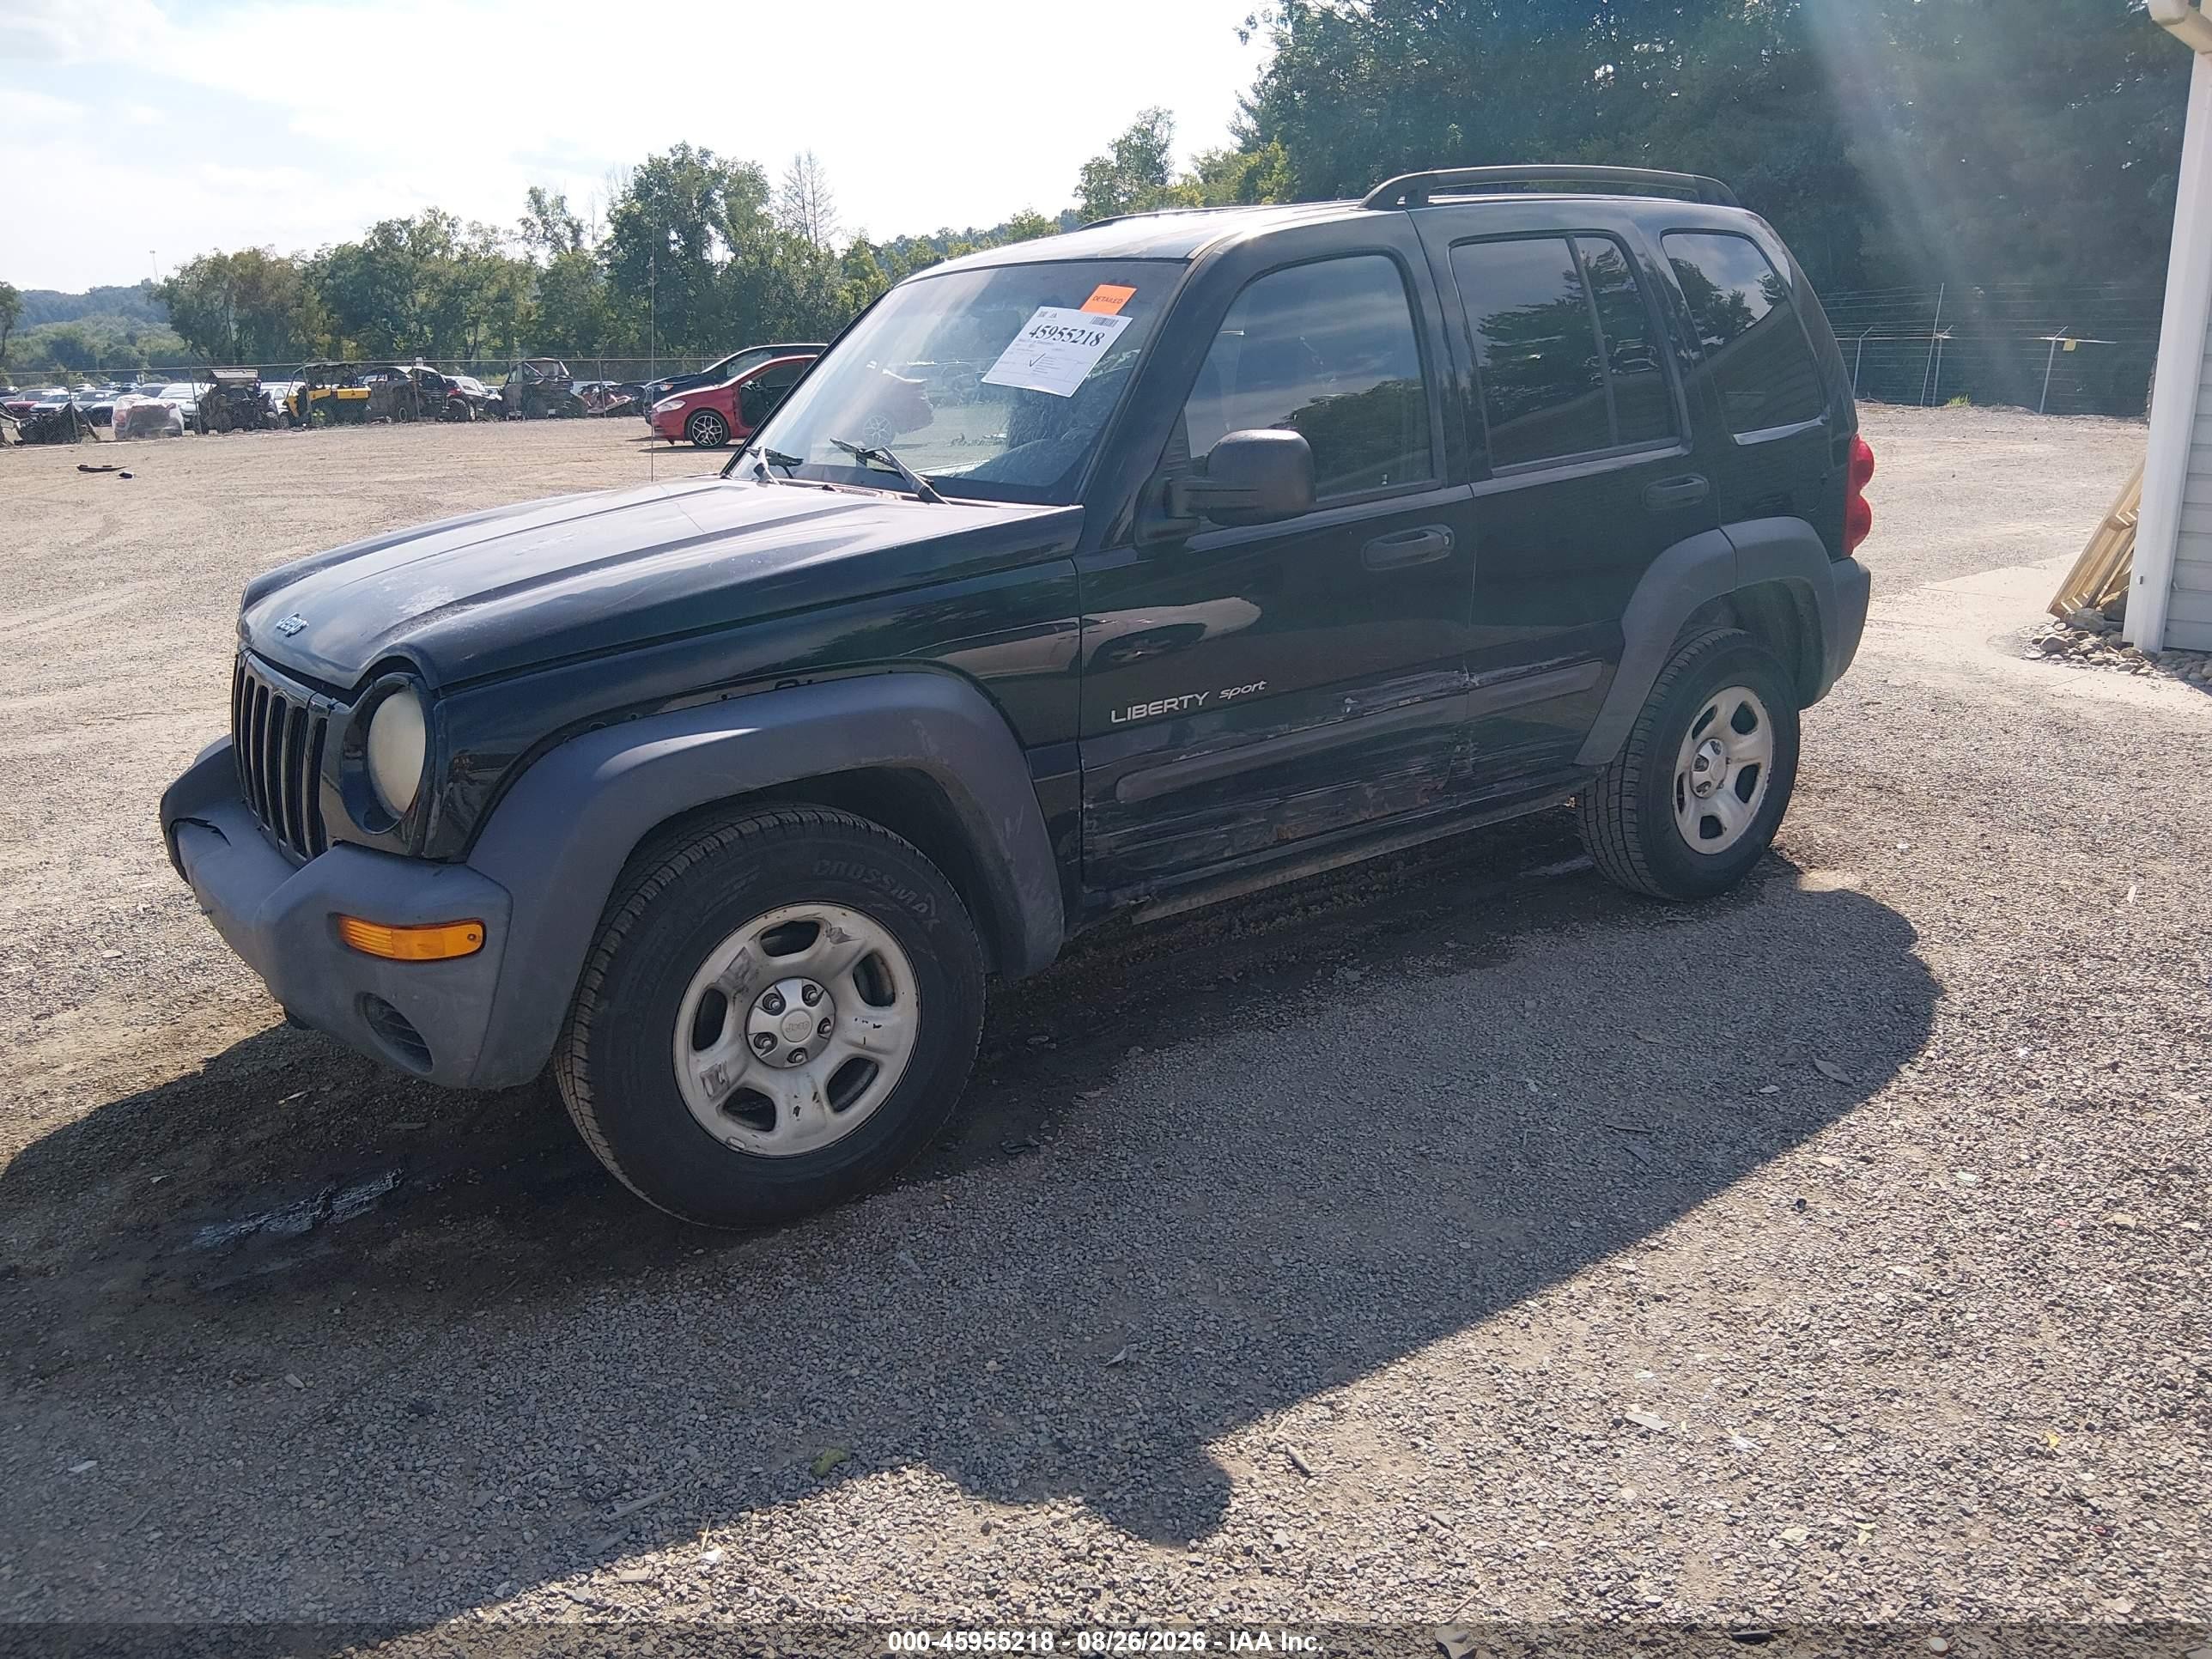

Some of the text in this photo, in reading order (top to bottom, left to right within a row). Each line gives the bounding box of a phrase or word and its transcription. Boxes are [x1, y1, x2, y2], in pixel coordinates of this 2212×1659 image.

[1092, 295, 1123, 304] DETAILED
[1029, 324, 1105, 347] 45955218
[275, 611, 309, 638] Jeep
[1110, 680, 1267, 723] LIBERTY sport
